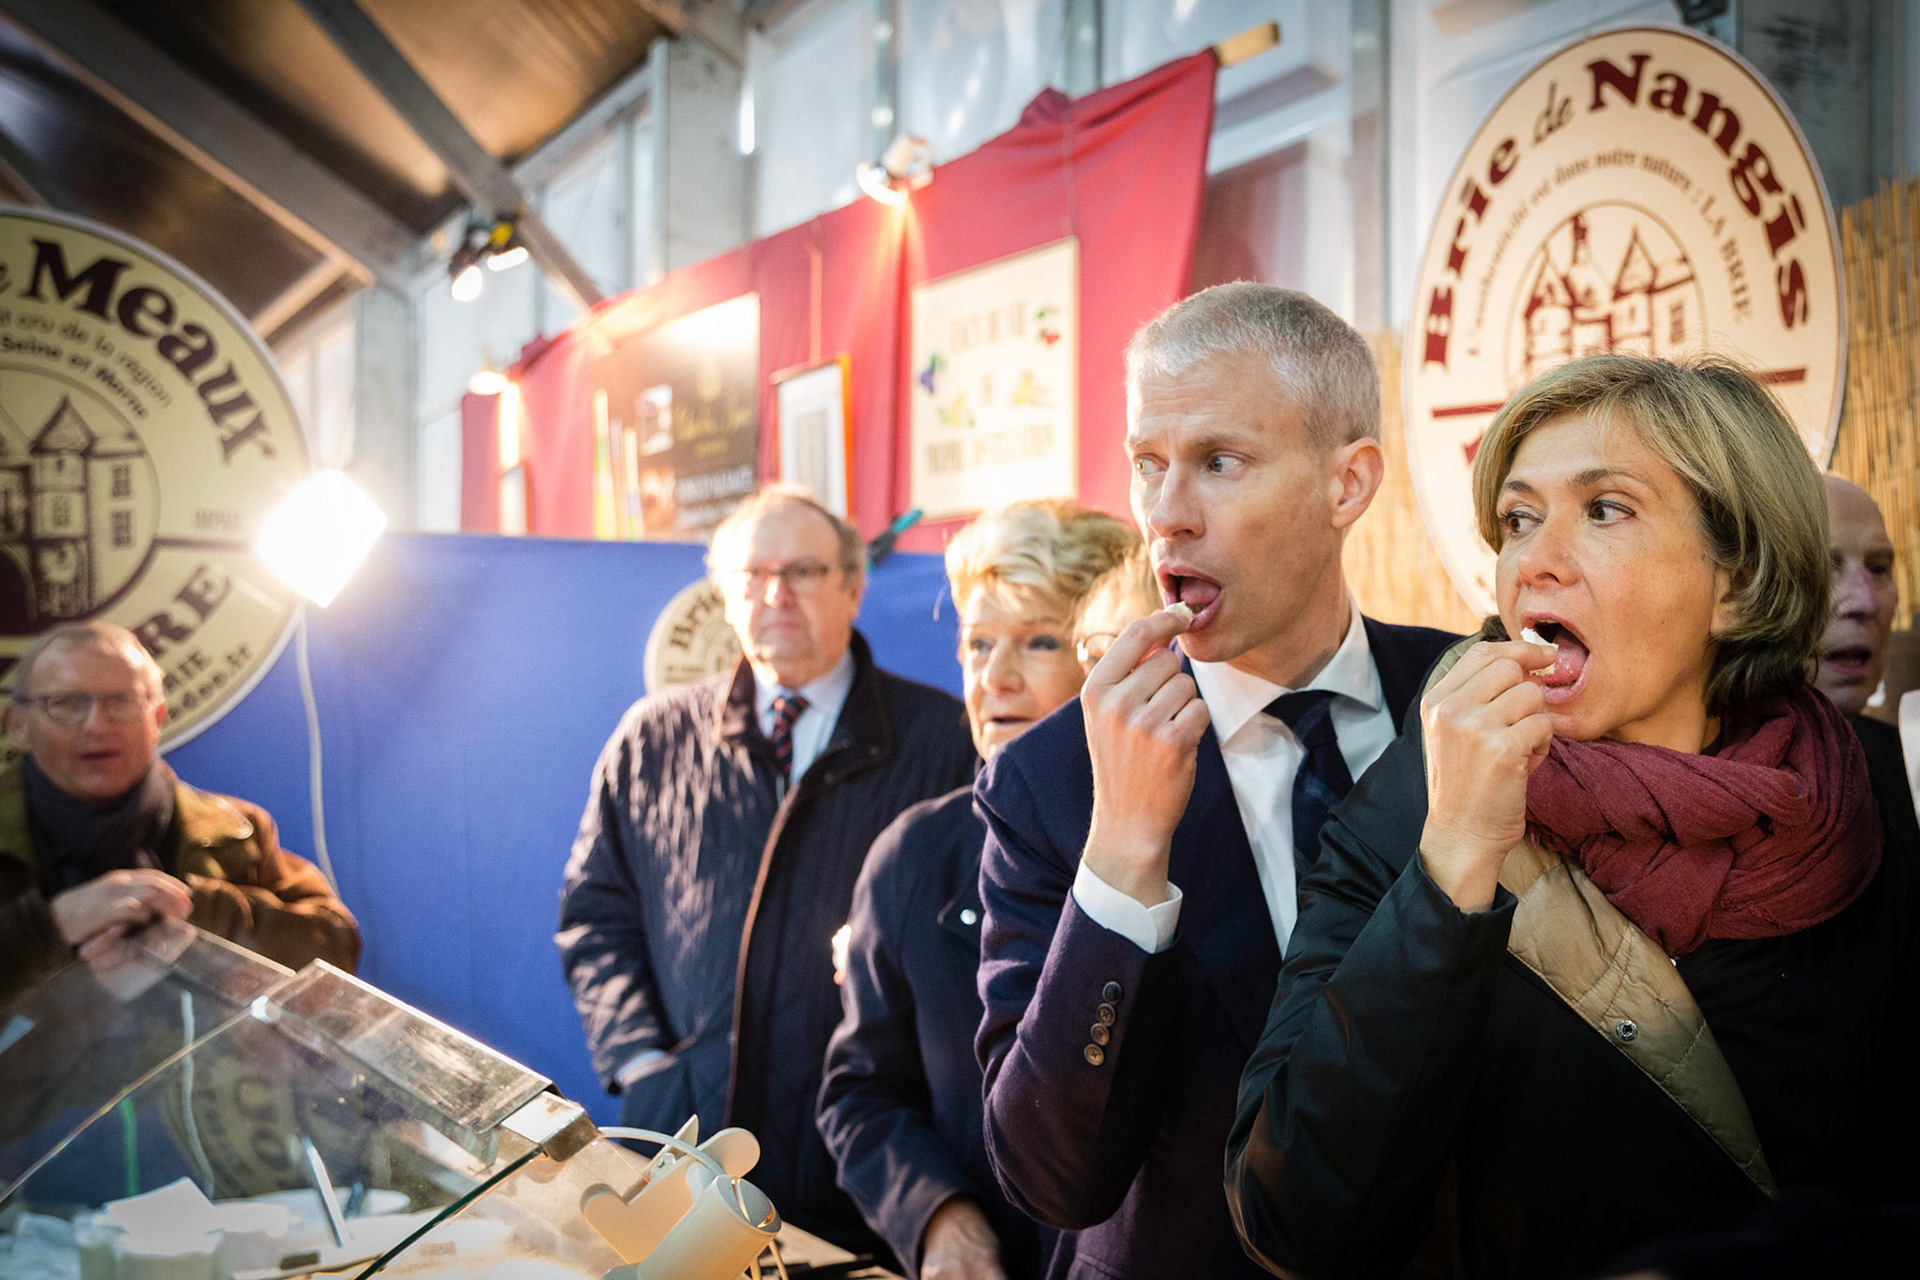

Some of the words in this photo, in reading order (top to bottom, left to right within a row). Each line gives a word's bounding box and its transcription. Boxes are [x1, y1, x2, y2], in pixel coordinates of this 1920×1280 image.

[1424, 136, 1520, 368] Brie
[1531, 77, 1576, 147] de
[1586, 53, 1808, 330] Nangis
[1593, 149, 1637, 169] notre
[1639, 154, 1693, 194] nature
[1702, 195, 1726, 238] LA
[1718, 236, 1753, 324] BRIE
[19, 236, 276, 465] Meaux
[58, 321, 90, 346] de
[116, 351, 173, 408] région
